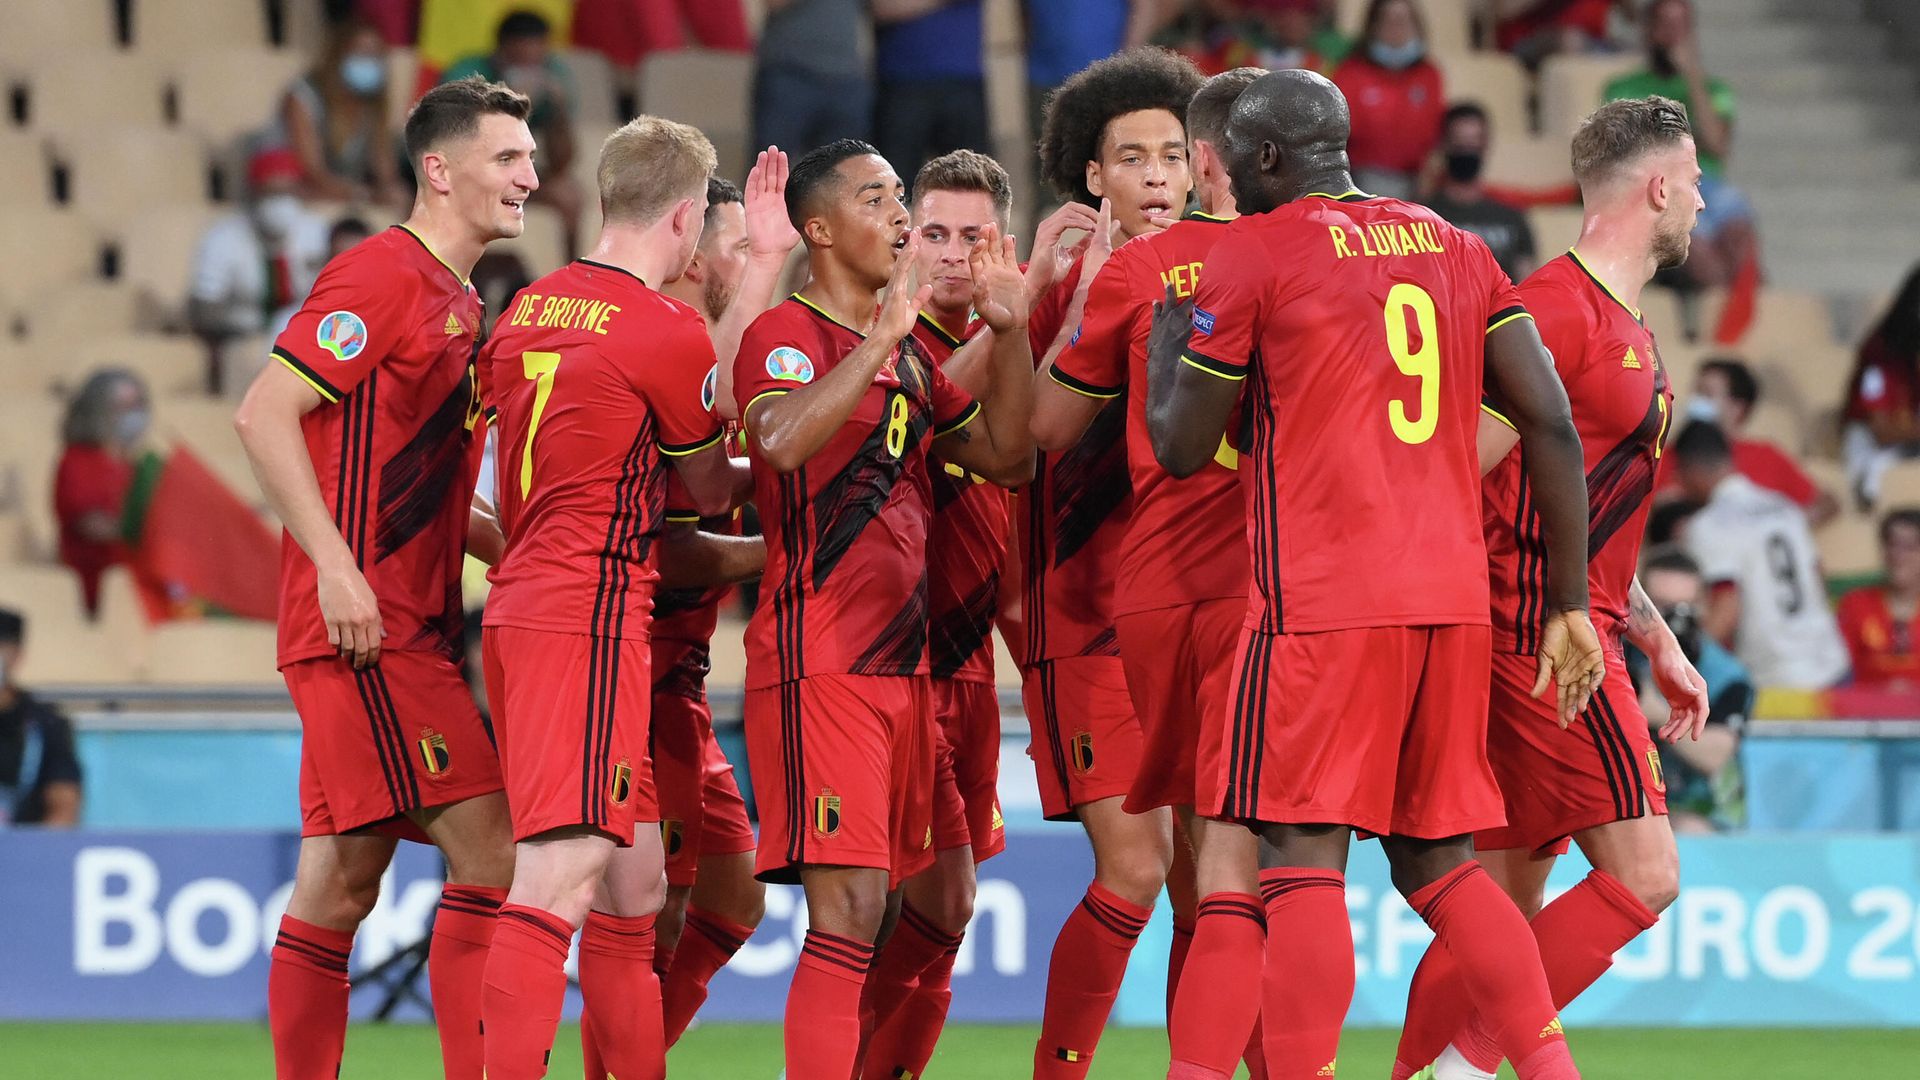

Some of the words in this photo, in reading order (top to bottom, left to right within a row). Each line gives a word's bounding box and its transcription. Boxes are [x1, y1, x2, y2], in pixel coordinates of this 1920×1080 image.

[1328, 224, 1358, 259] R.
[1354, 221, 1445, 257] LUKAKU
[510, 293, 542, 328] DE
[536, 295, 622, 335] BRUYNE
[1383, 282, 1441, 445] 9
[520, 350, 562, 503] 7
[886, 392, 909, 460] 8
[1541, 882, 1831, 980] URO
[1846, 886, 1920, 979] 2
